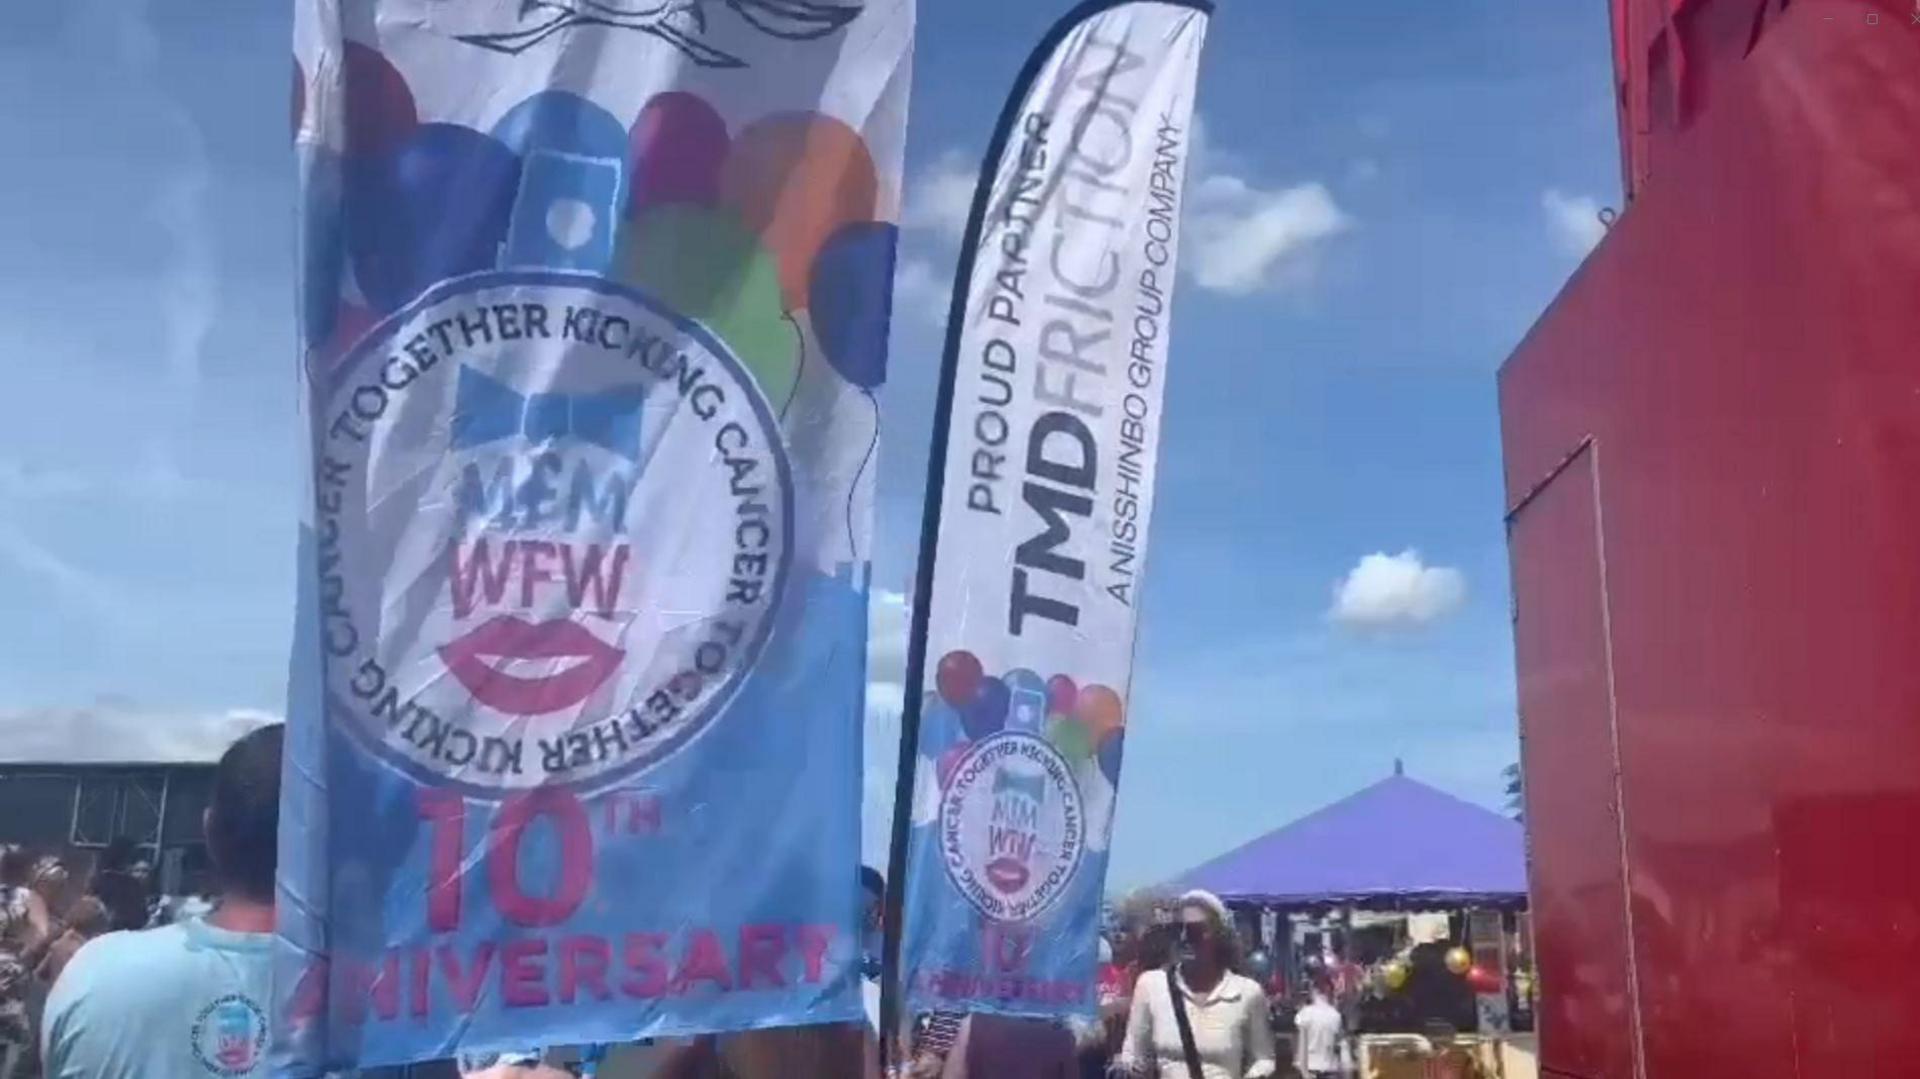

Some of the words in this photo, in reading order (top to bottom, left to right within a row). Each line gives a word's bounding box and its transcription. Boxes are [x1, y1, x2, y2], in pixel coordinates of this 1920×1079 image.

[988, 111, 1050, 325] PARTNER
[1144, 110, 1182, 267] COMPANY
[1128, 269, 1164, 388] GROUP
[329, 302, 552, 446] TOGETHER
[560, 304, 725, 424] KICKING
[714, 420, 770, 607] CANCER
[967, 338, 1018, 515] PROUD
[1109, 393, 1148, 577] NISSHINBO
[448, 536, 631, 620] WFW
[1106, 581, 1131, 606] A
[350, 657, 524, 777] KICKING
[540, 619, 746, 774] TOGETHER
